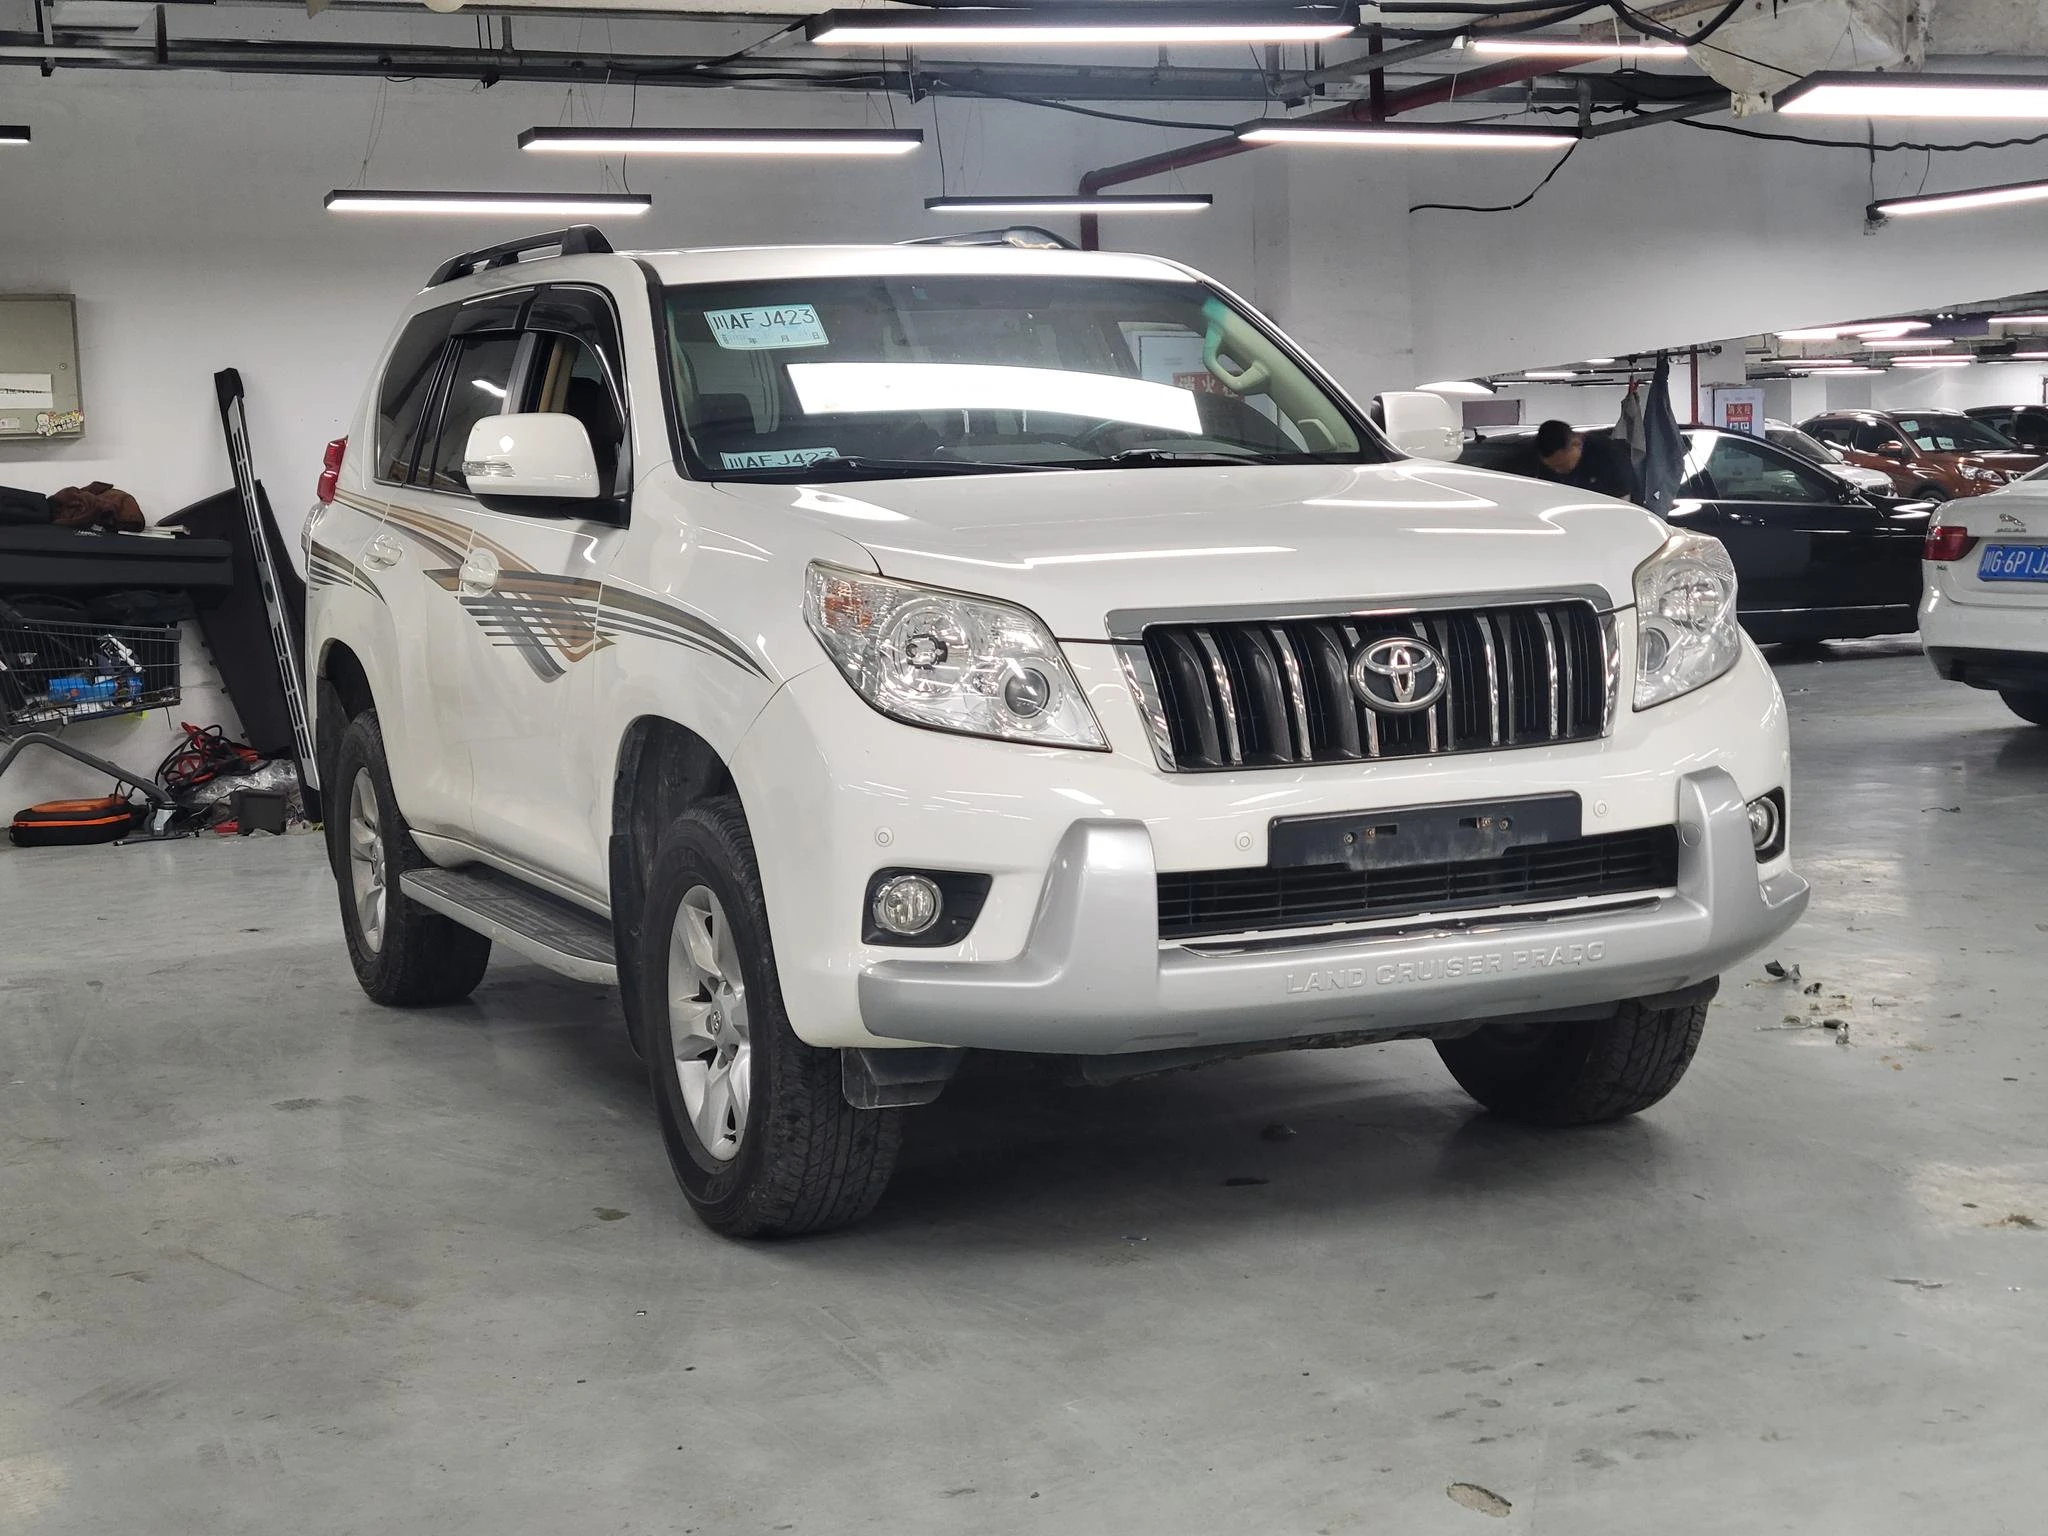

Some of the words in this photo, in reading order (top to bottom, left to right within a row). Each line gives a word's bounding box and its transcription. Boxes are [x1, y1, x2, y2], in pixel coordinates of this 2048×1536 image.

[1287, 967, 1367, 994] LAND
[1376, 953, 1503, 985] CRUISER
[1512, 941, 1606, 971] PRADO
